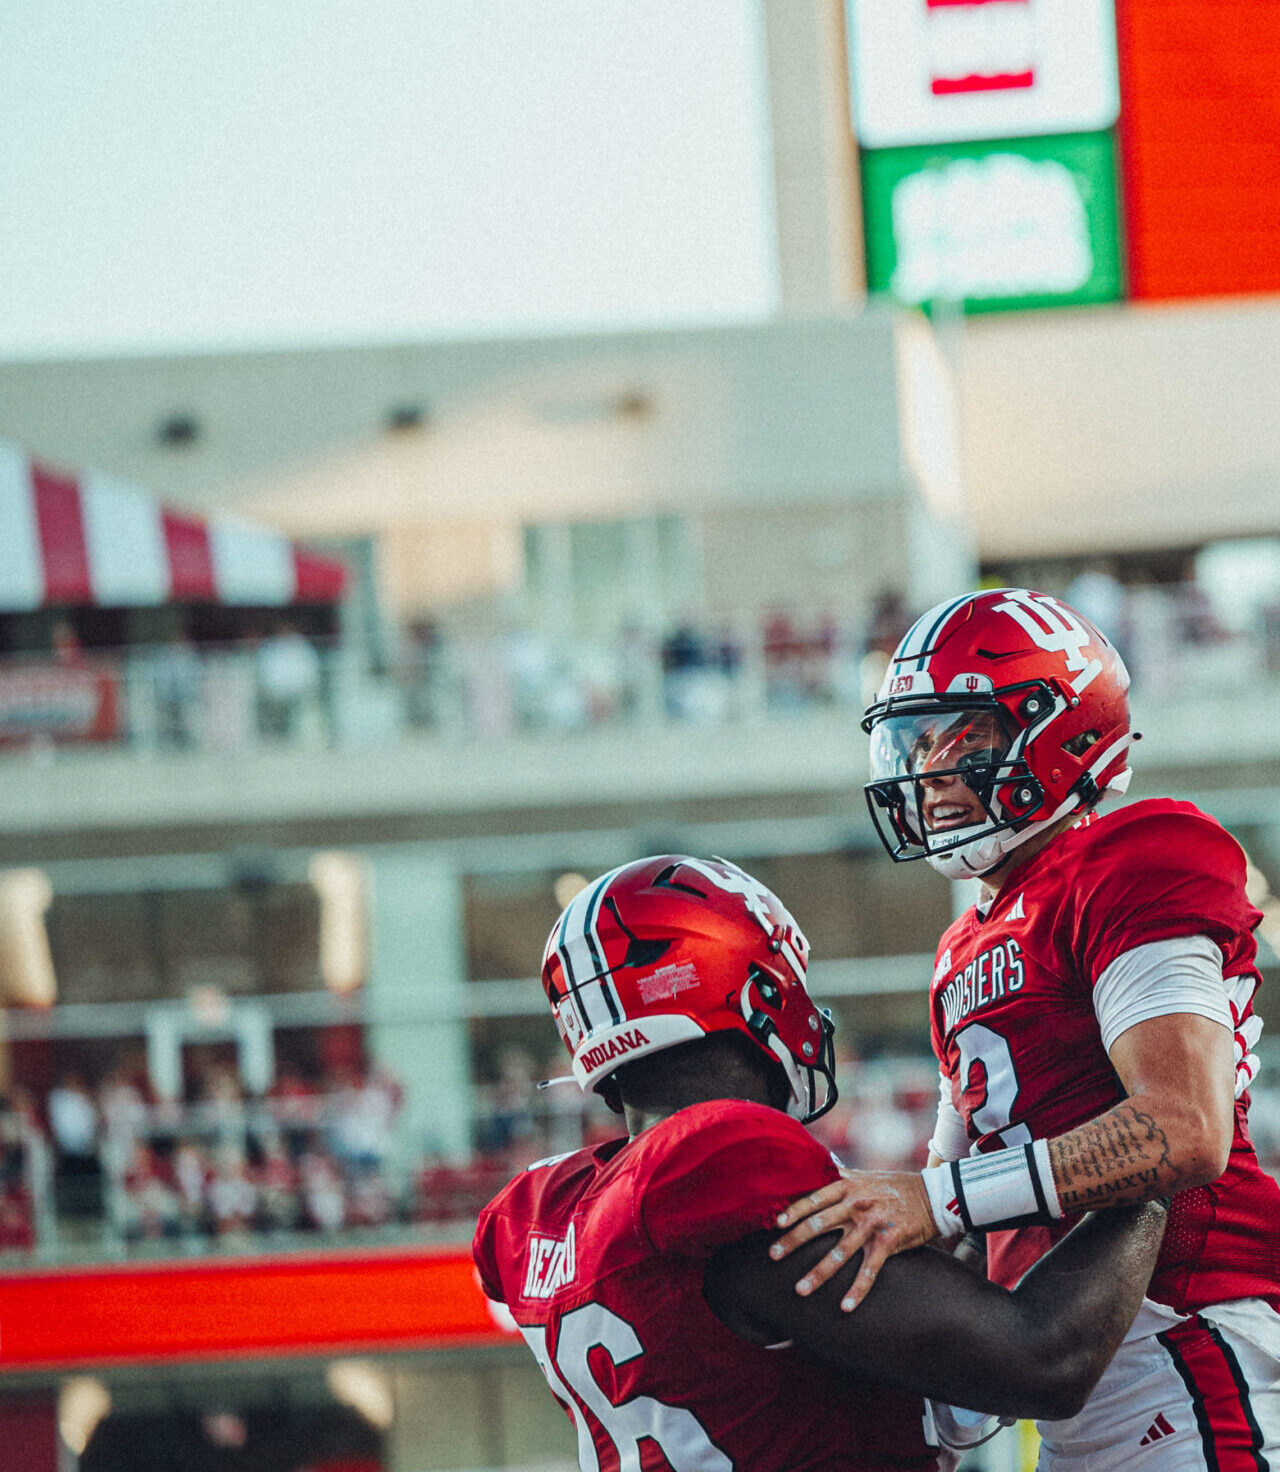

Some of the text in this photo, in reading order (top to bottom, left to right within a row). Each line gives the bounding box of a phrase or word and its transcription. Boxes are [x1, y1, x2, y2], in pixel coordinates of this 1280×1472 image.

[940, 936, 1025, 1037] HOOSIERS
[579, 1028, 651, 1074] INDIANA
[519, 1301, 736, 1472] 76
